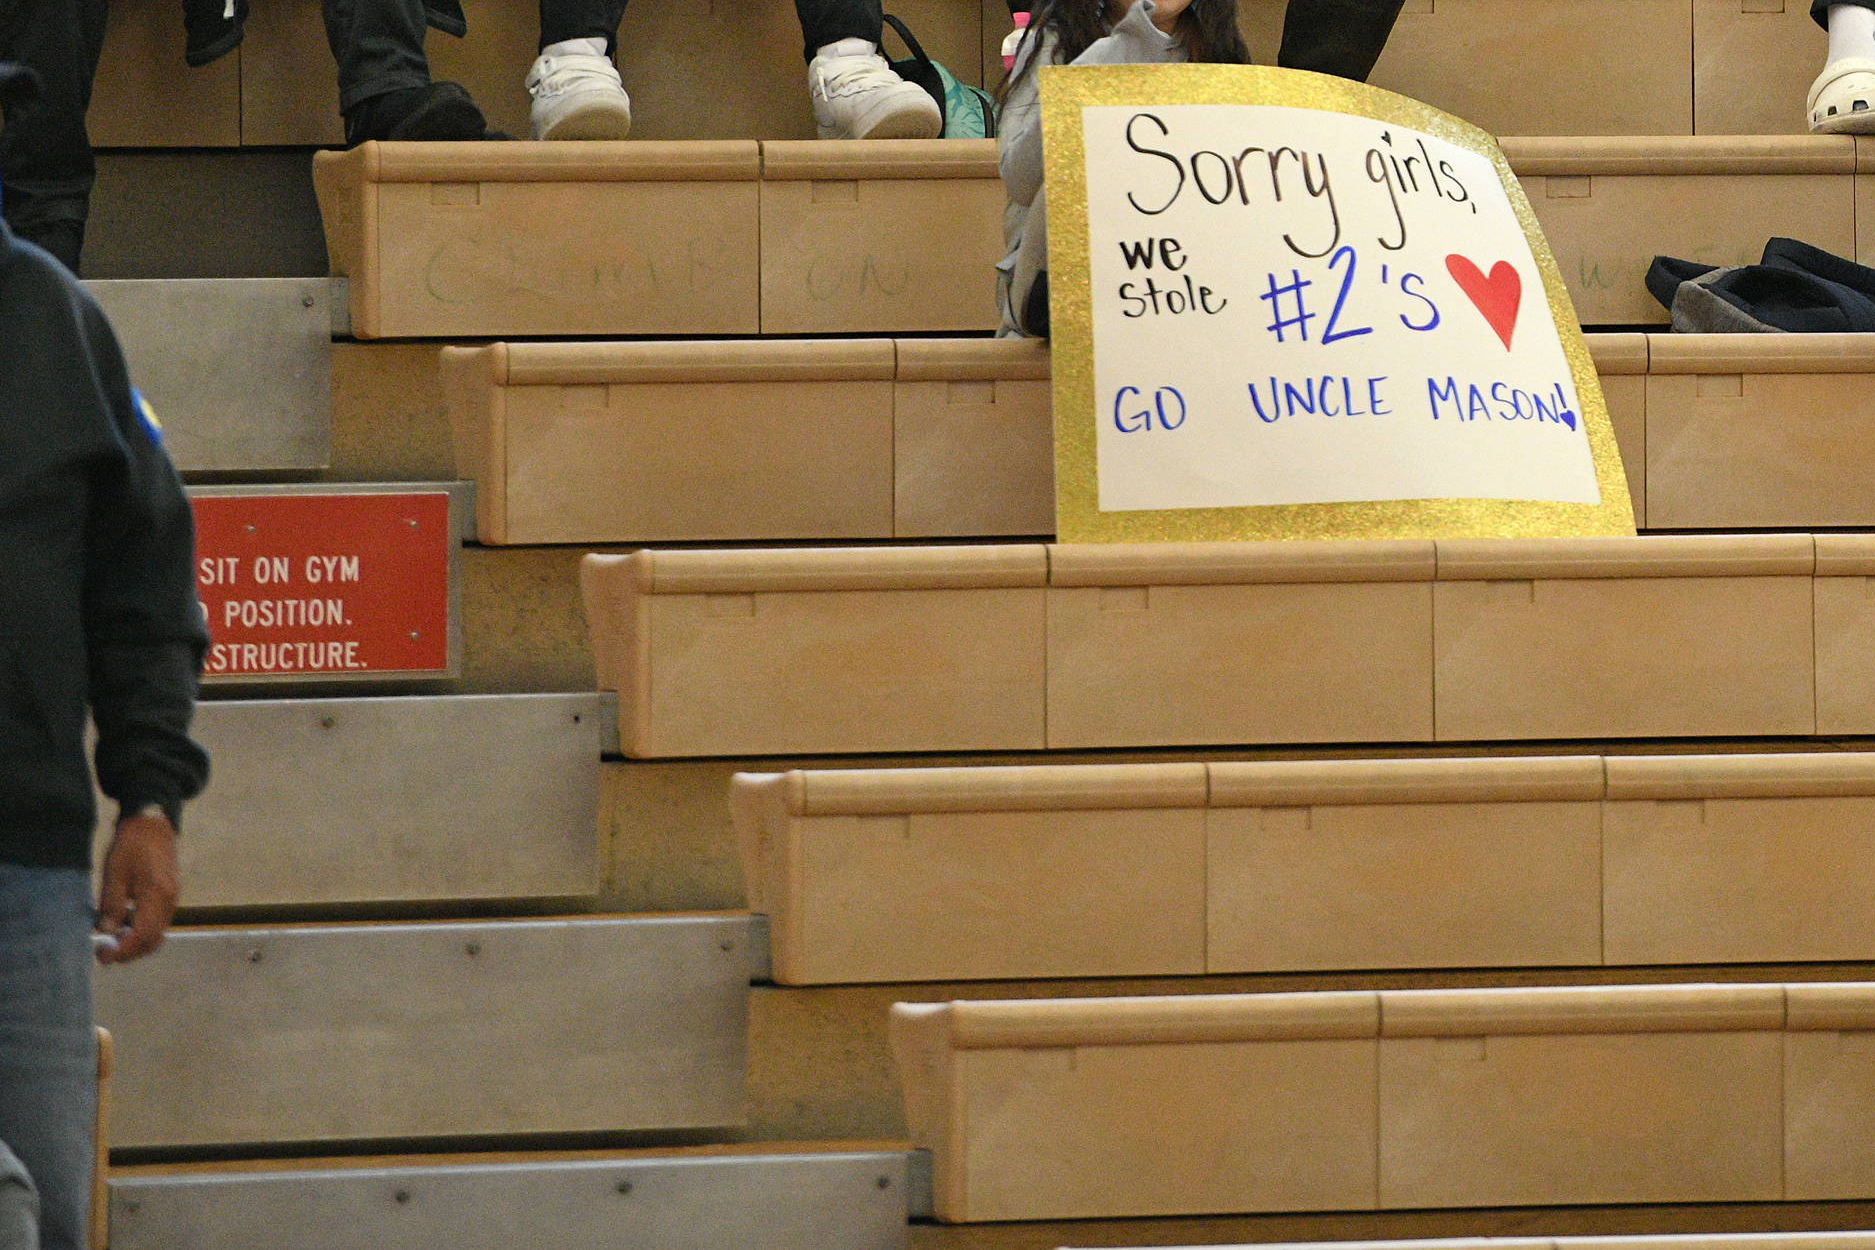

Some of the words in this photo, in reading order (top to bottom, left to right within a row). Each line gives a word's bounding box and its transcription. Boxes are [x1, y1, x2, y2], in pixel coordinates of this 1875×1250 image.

[1126, 112, 1340, 258] Sorry
[1365, 129, 1477, 250] girls,
[1119, 234, 1188, 272] we
[1119, 274, 1228, 319] stole
[1260, 245, 1440, 346] #2's
[1114, 385, 1187, 434] GO
[1247, 375, 1395, 425] UNCLE
[1428, 375, 1579, 433] MASON!
[199, 556, 240, 586] SIT
[253, 555, 290, 584] ON
[305, 554, 360, 584] GYM
[224, 598, 353, 629] POSITION.
